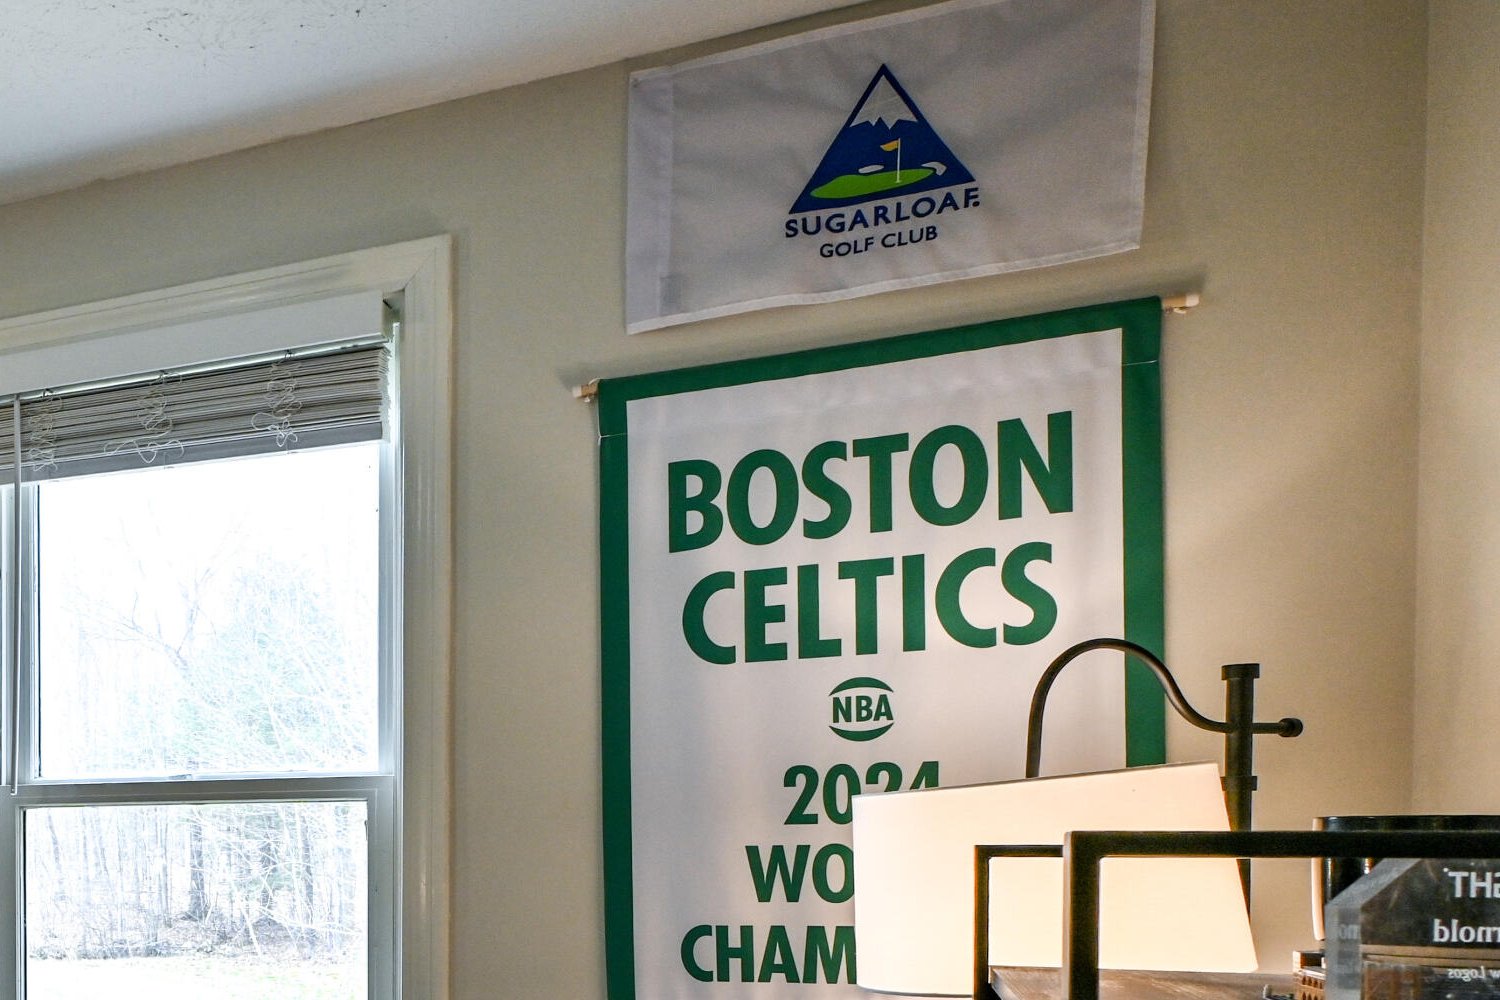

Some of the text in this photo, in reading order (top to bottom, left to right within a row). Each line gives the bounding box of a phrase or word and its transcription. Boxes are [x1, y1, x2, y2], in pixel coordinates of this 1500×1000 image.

[819, 225, 938, 258] GOLF CLUB
[667, 410, 1074, 554] BOSTON
[682, 541, 1059, 665] CELTICS
[831, 693, 894, 723] NBA
